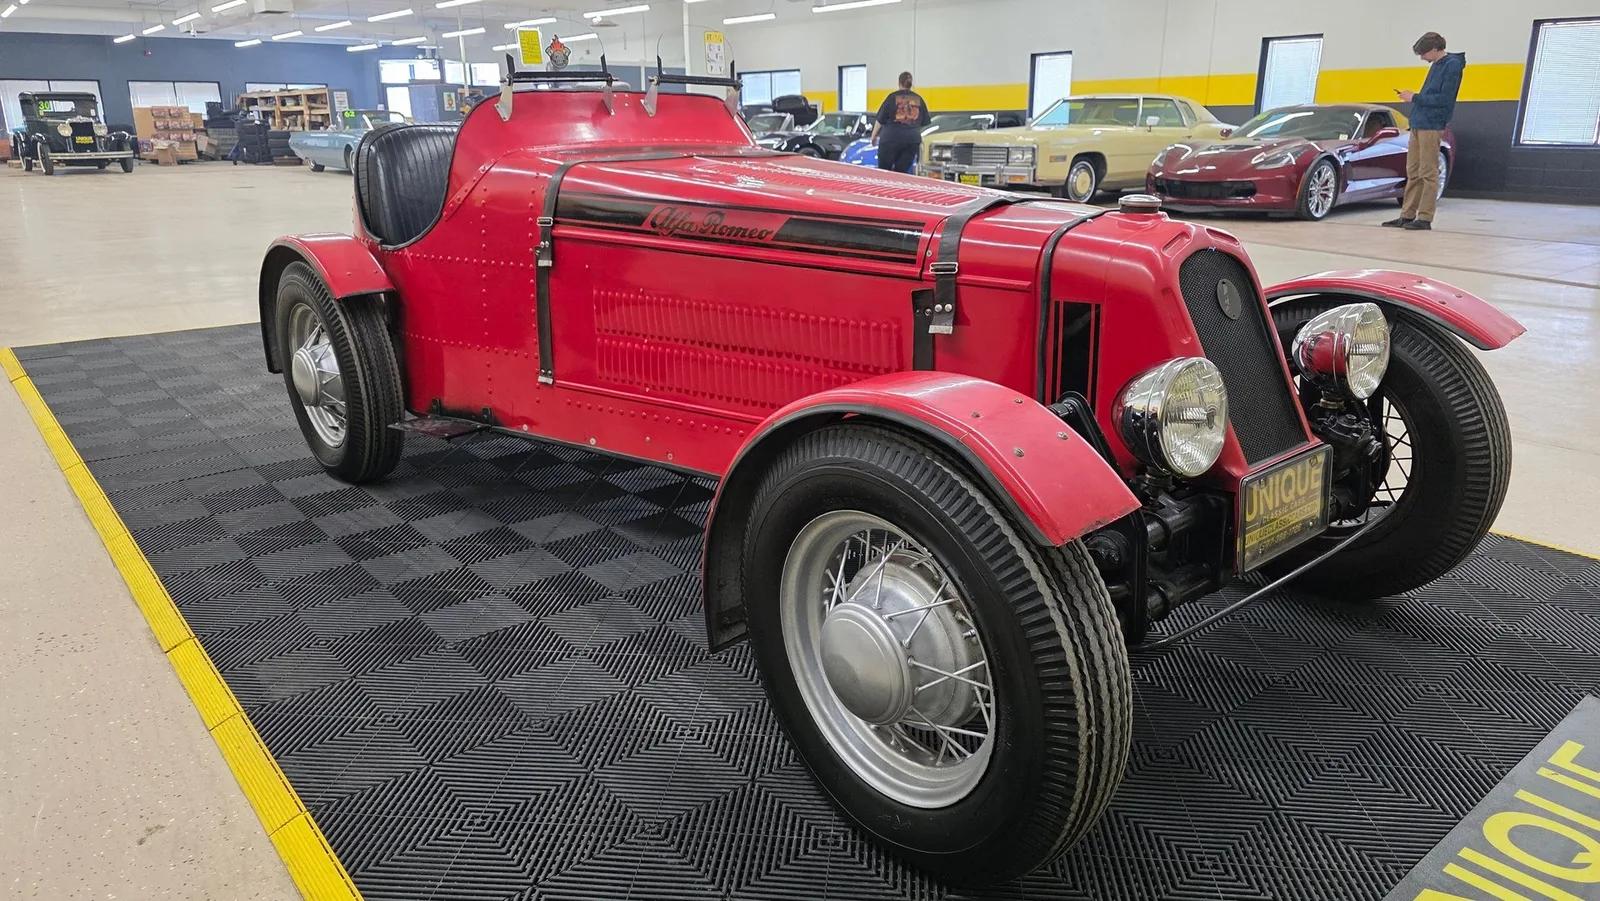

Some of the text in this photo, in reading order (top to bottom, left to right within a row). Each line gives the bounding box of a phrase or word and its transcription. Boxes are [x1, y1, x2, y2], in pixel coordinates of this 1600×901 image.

[39, 101, 49, 110] 30
[650, 206, 774, 240] Alfa Romeo
[1246, 452, 1325, 522] UNIQUE
[1263, 504, 1289, 523] CLASSIC
